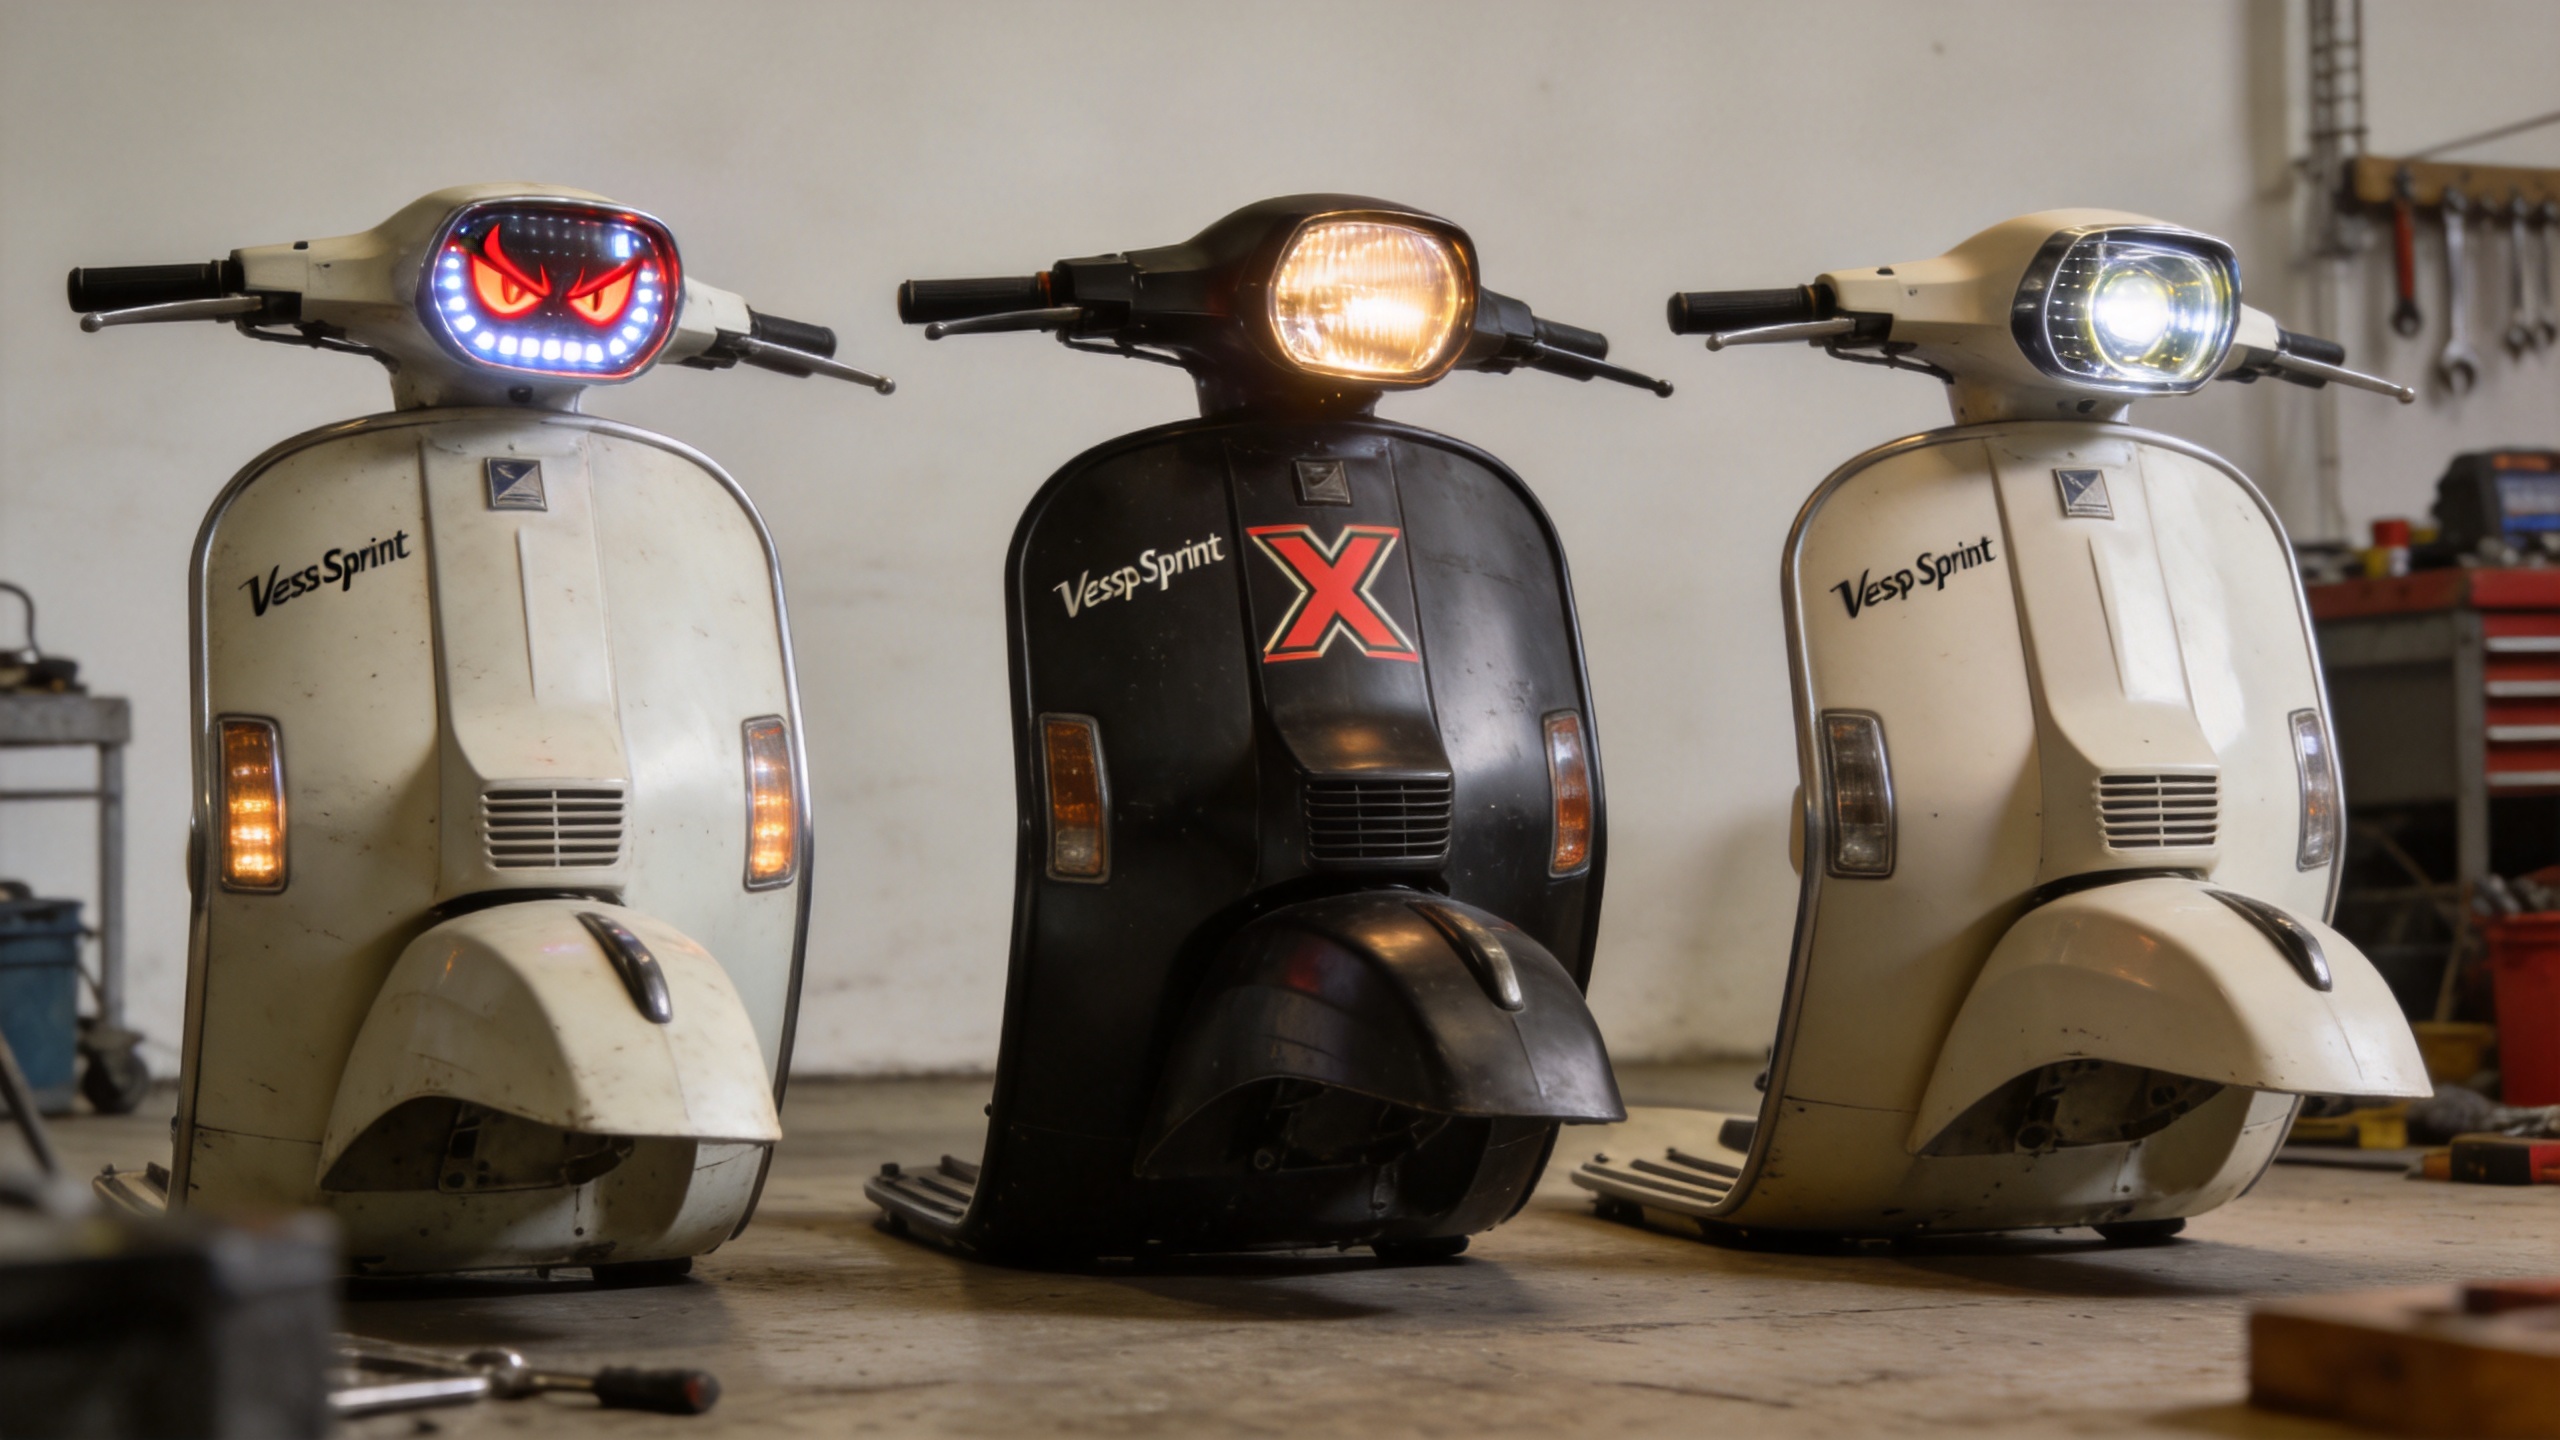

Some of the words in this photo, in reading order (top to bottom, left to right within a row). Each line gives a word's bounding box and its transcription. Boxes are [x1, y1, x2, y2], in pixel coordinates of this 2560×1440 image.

[238, 564, 321, 617] Vess
[323, 529, 411, 592] Sprint
[1052, 569, 1141, 618] Vessp
[1139, 532, 1226, 591] Sprint
[1245, 523, 1420, 664] X
[1829, 568, 1915, 619] Vesp
[1916, 535, 1997, 591] Sprint
